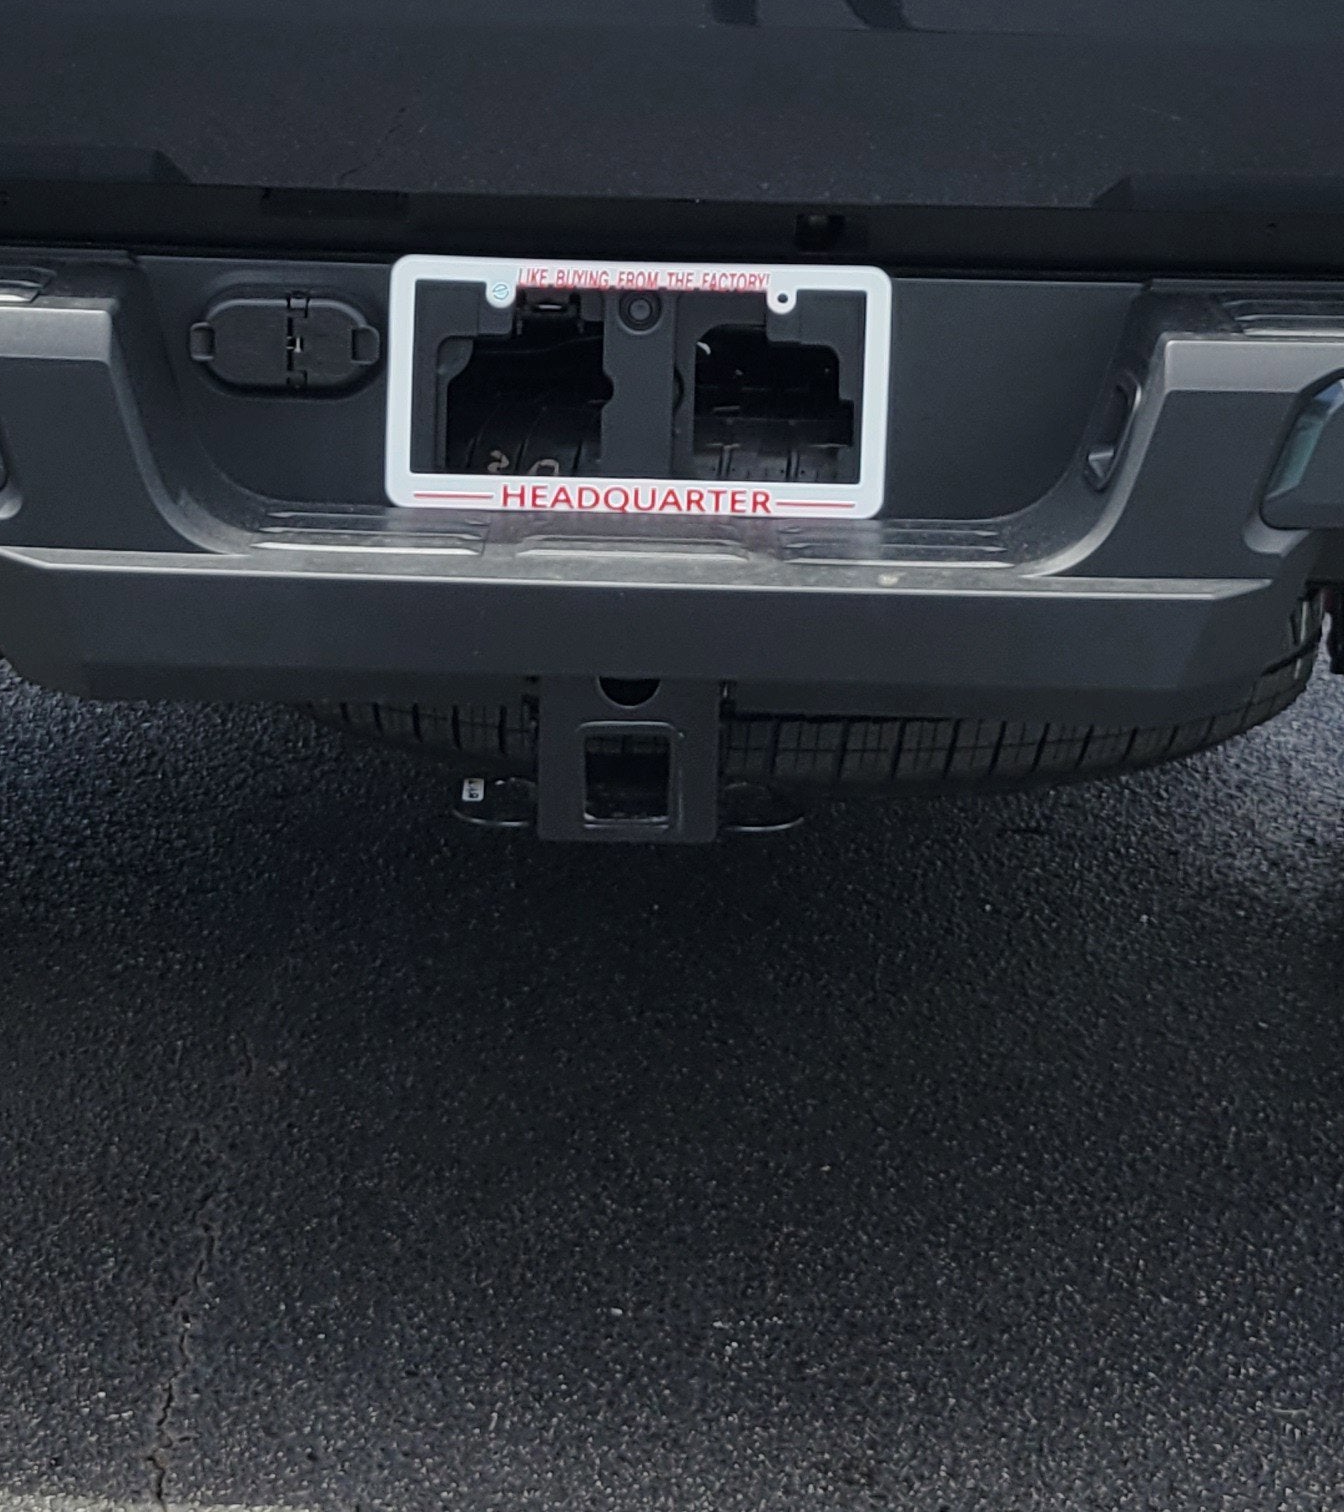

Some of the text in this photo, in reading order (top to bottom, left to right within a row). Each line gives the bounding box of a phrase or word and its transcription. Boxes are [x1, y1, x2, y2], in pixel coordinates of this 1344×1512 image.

[518, 268, 771, 291] LIKE BUYING FROM THE FACTORY!
[502, 484, 772, 514] HEADQUARTER
